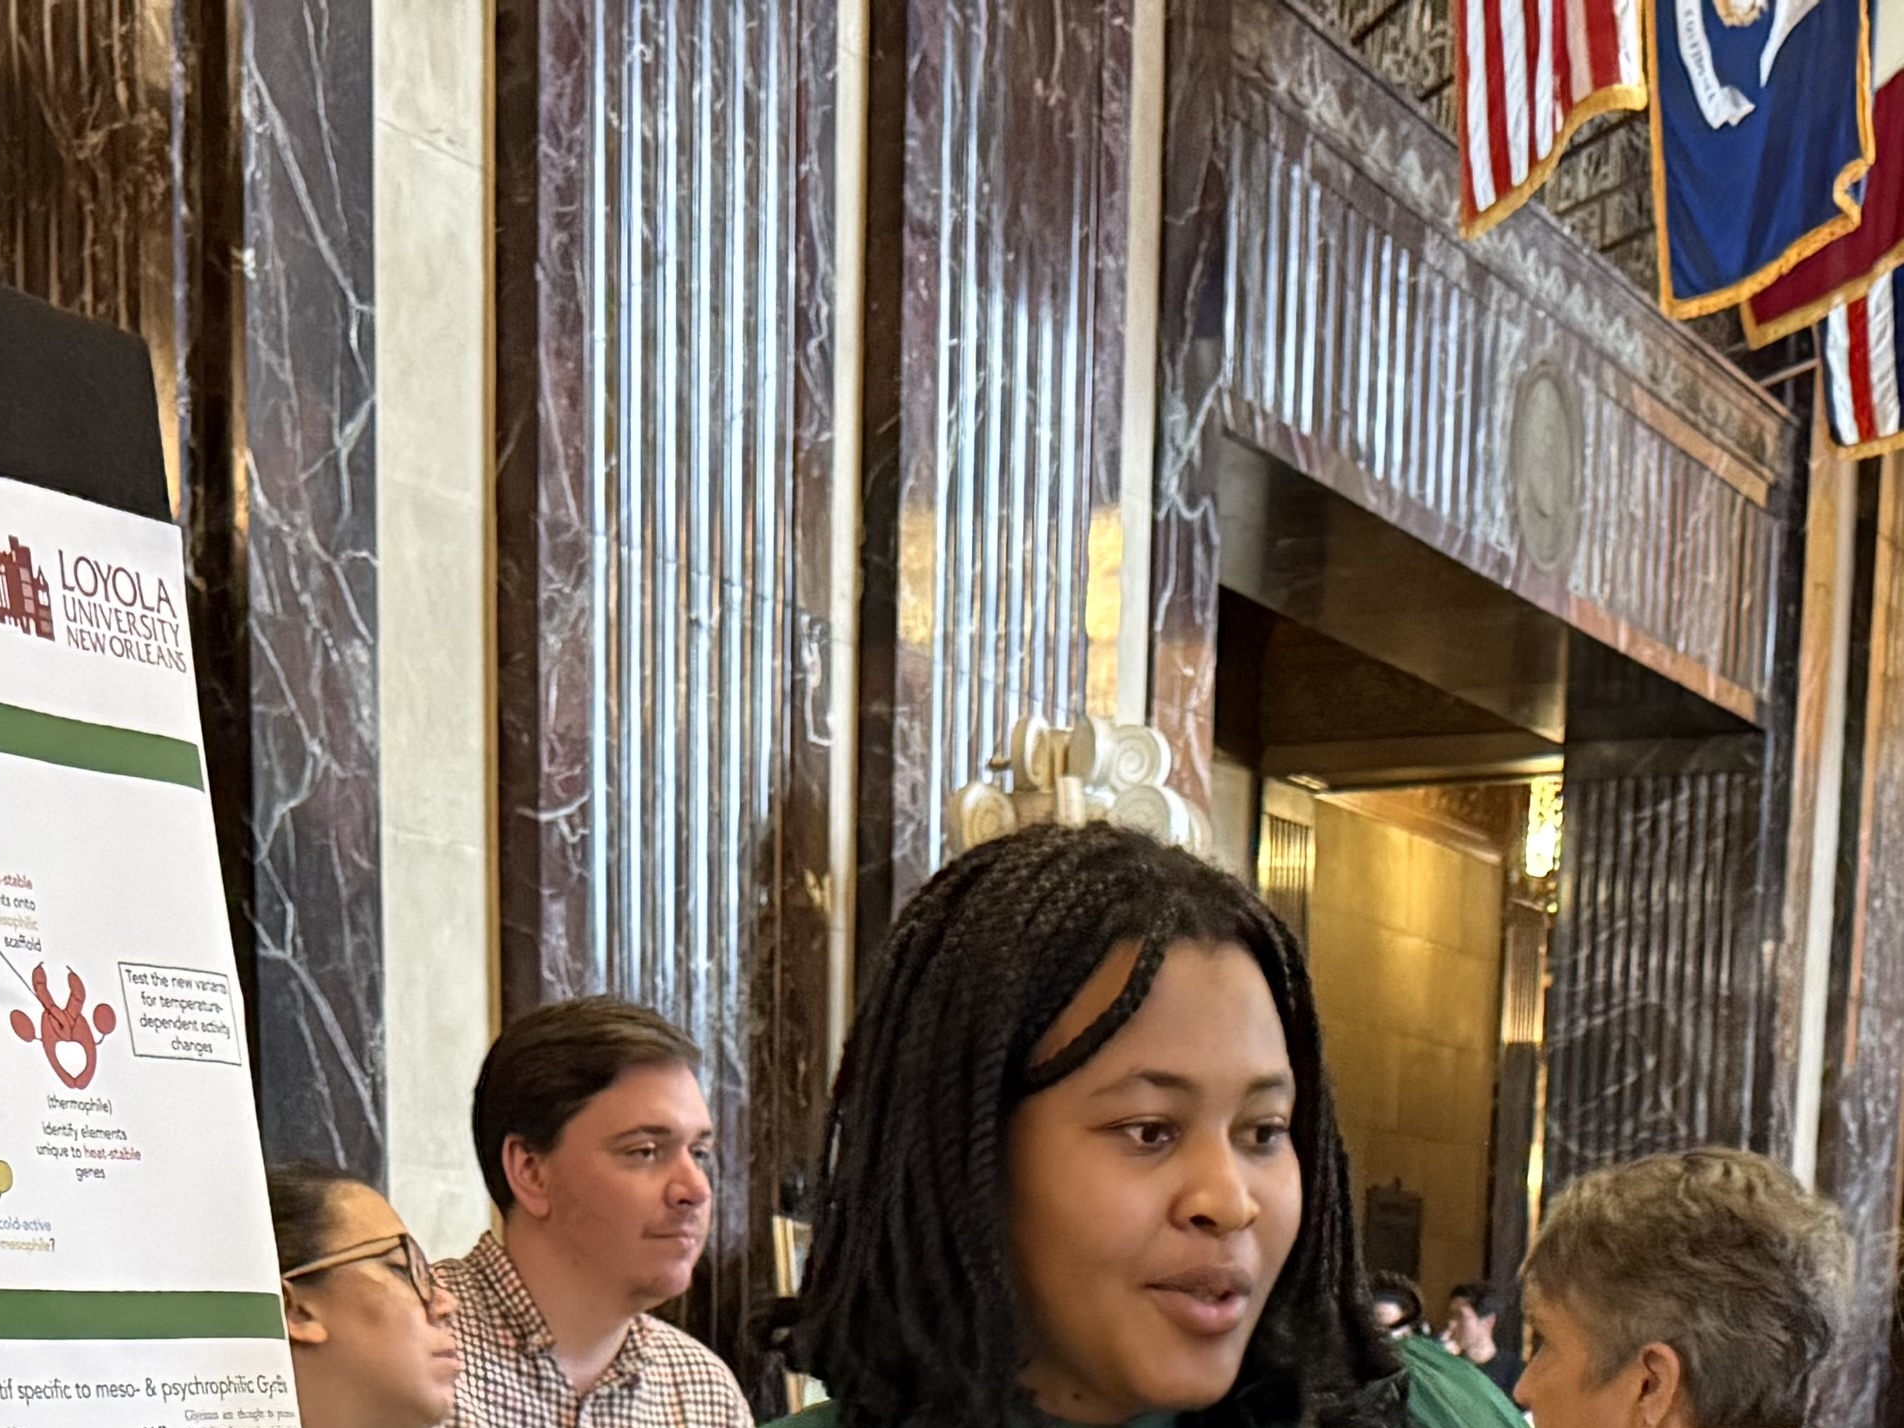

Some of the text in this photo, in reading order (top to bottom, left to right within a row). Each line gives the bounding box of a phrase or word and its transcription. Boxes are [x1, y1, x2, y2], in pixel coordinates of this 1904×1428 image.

[58, 549, 177, 619] LOYOLA
[62, 594, 180, 648] UNIVERSITY
[66, 625, 187, 674] NEW ORLEANS
